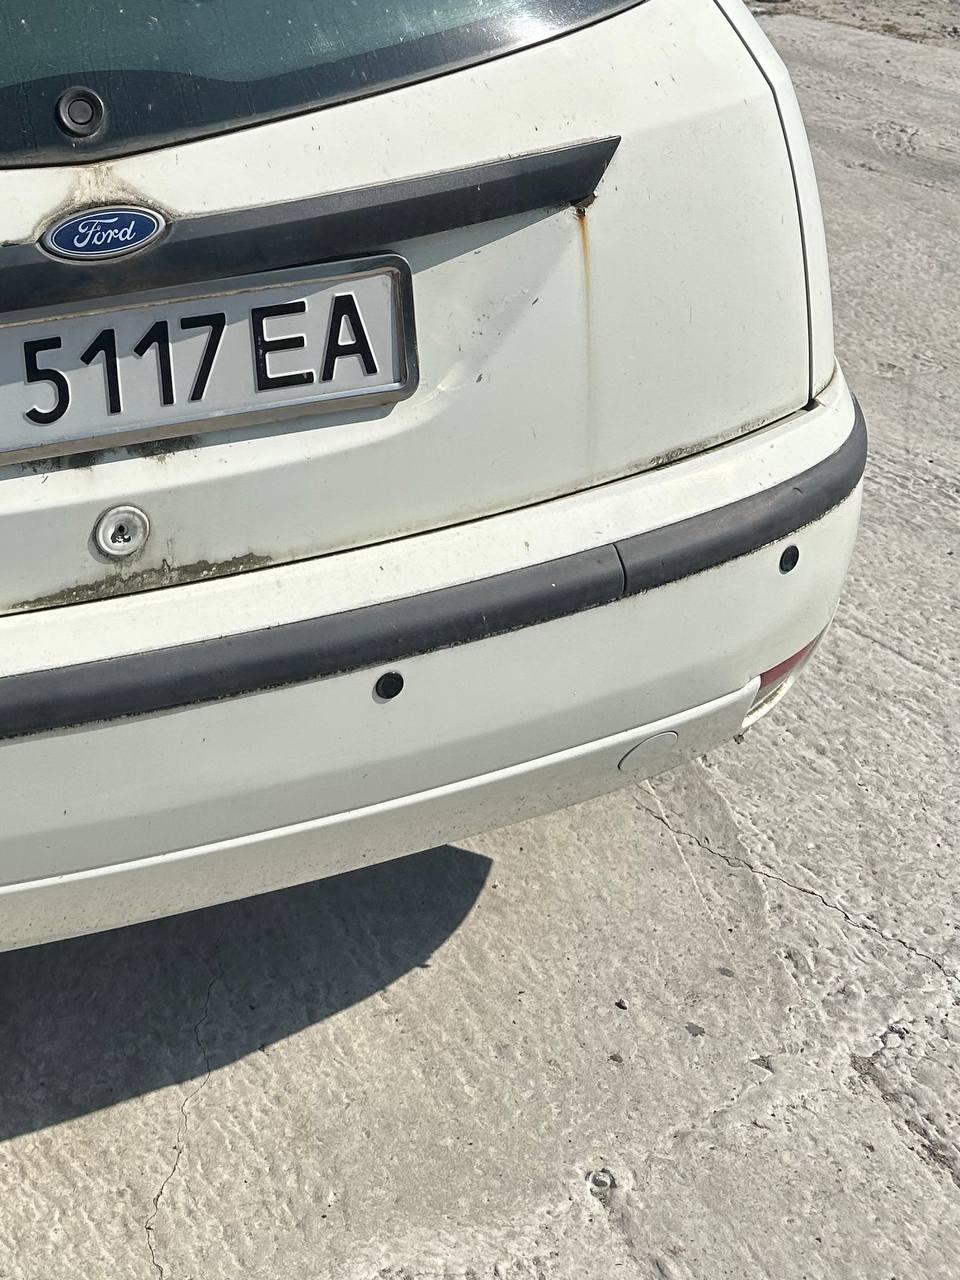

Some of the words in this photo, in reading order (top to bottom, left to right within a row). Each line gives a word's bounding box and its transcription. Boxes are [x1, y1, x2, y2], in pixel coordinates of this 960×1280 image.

[73, 216, 136, 248] Ford
[23, 312, 227, 425] 5117
[251, 291, 380, 392] EA
